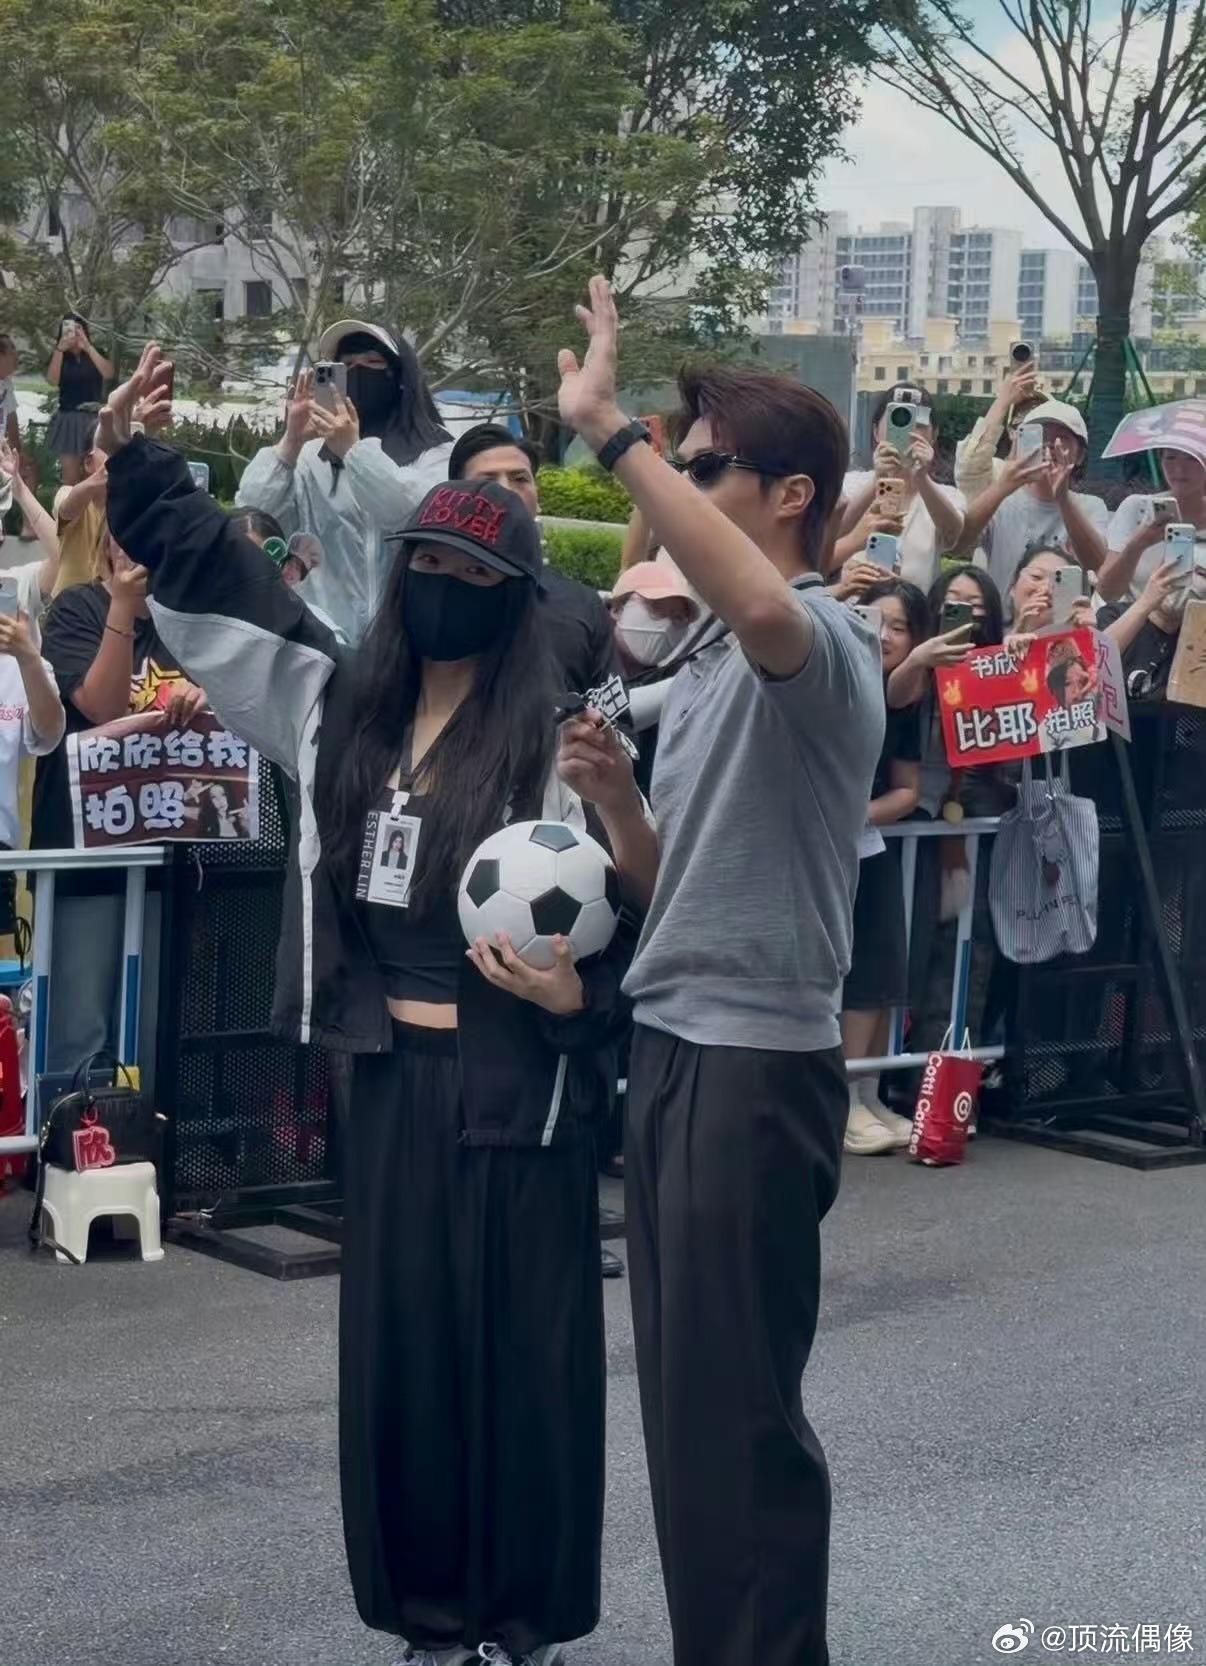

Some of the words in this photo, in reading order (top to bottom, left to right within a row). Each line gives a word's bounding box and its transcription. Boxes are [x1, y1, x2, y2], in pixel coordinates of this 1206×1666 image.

[420, 503, 498, 544] LOVER
[970, 652, 1019, 679] 书欣
[955, 703, 1038, 751] 比耶
[1045, 701, 1097, 734] 拍照
[80, 729, 248, 773] 欣欣给我
[86, 781, 185, 835] 拍照
[361, 811, 378, 868] ESTHER
[356, 873, 369, 899] LIN
[921, 1054, 942, 1095] Cotti
[909, 1098, 931, 1154] Coffee
